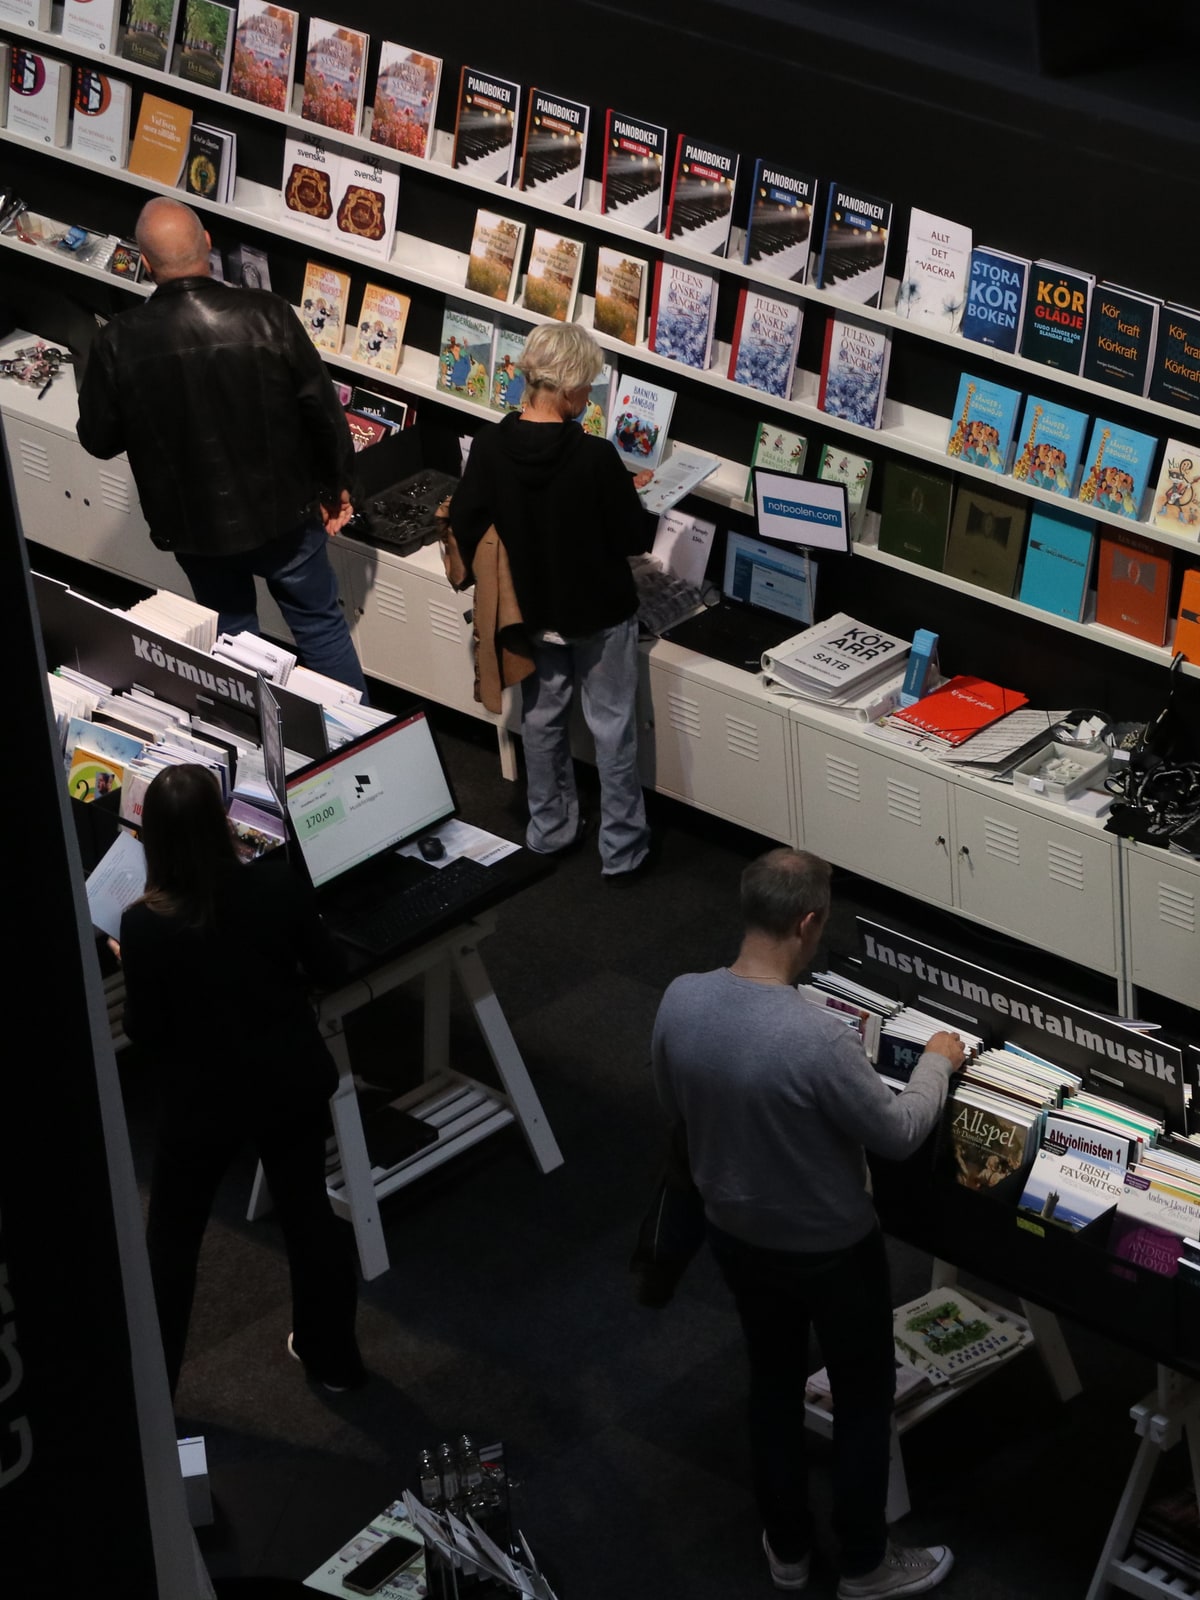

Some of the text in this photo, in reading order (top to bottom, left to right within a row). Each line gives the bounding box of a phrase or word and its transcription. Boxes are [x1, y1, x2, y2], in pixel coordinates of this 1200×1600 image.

[468, 77, 510, 102] PIANOBOKEN
[537, 98, 580, 124] PIANOBOKEN
[614, 120, 658, 146] PIANOBOKEN
[297, 149, 326, 163] svenska
[685, 145, 731, 171] PIANOBOKEN
[354, 169, 383, 184] svenska
[763, 169, 809, 196] PIANOBOKEN
[837, 193, 884, 220] PIANOBOKEN
[931, 231, 950, 244] ALLT
[931, 248, 948, 259] DET
[671, 268, 703, 289] JULENS
[920, 262, 955, 280] VACKRA
[972, 260, 1020, 288] STORA
[670, 281, 701, 300] ÖNSKE
[970, 280, 1017, 314] KÖR
[1036, 280, 1085, 314] KÖR
[755, 298, 788, 318] JULENS
[967, 304, 1016, 330] BOKEN
[1035, 305, 1084, 330] GLÄDJE
[1101, 303, 1120, 320] Kör
[754, 311, 786, 330] ÖNSKE
[1118, 320, 1141, 339] kraft
[843, 326, 875, 347] JULENS
[1039, 330, 1062, 340] BLANDAD
[1051, 328, 1070, 337] SÅNGER
[1071, 332, 1081, 340] FÖR
[1169, 323, 1187, 341] Kör
[841, 339, 873, 359] ÖNSKE
[1098, 336, 1137, 360] Körkraft
[634, 385, 658, 401] BARNENS
[768, 501, 838, 523] notpoolen.com
[828, 638, 879, 661] ARR
[844, 628, 895, 654] KÖR
[131, 634, 256, 708] Körmusik
[813, 653, 850, 671] SATB
[305, 806, 335, 829] 170,00
[864, 934, 1175, 1084] Instrumentalmusik
[953, 1108, 1017, 1147] Allspel
[1050, 1129, 1121, 1163] Altviolinisten 1
[1060, 1165, 1122, 1196] FAVORITES
[1079, 1162, 1110, 1181] IRISH
[1147, 1192, 1187, 1213] Andrew Lloyd
[1128, 1241, 1177, 1265] ANDREW
[1133, 1253, 1169, 1274] LLOYD
